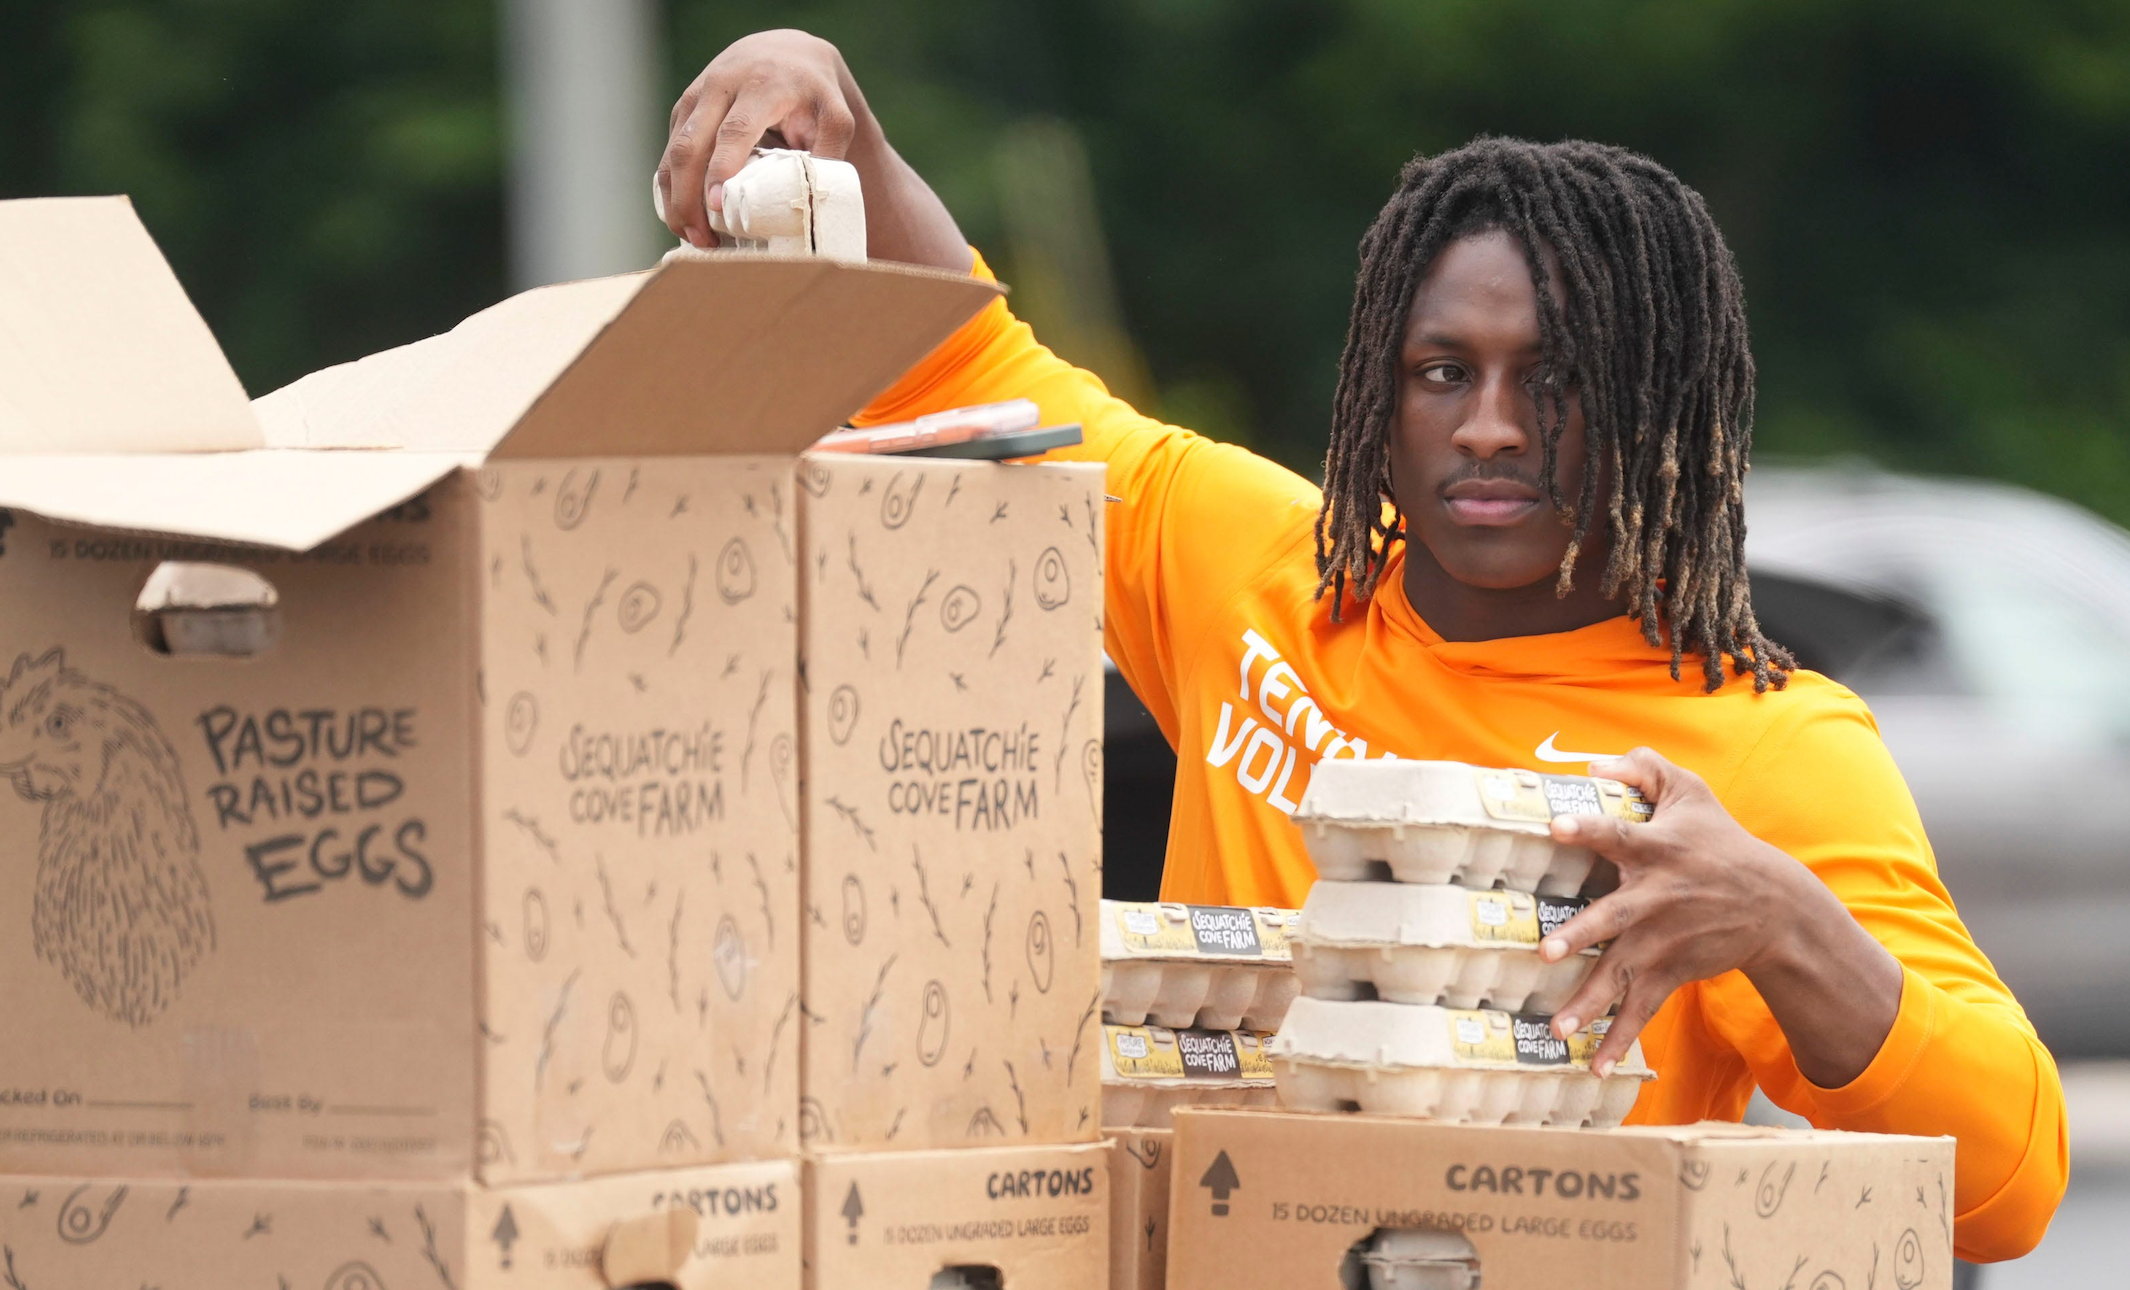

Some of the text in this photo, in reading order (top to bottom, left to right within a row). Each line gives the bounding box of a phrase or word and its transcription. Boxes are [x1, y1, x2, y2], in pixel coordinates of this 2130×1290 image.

[194, 705, 419, 776] PASTURE
[1206, 701, 1317, 816] VOL
[205, 767, 405, 830] RAISED
[569, 780, 726, 838] COVE FARM
[888, 778, 1039, 832] COVE FARM
[245, 817, 434, 904] EGGS
[1199, 930, 1257, 950] COVE FARM
[1184, 1052, 1237, 1073] COVE FARM
[1517, 1039, 1567, 1060] COVE FARM
[53, 1088, 83, 1107] On
[986, 1167, 1095, 1200] CARTONS
[1445, 1163, 1642, 1202] CARTONS
[1017, 1216, 1058, 1238] LARGE
[1058, 1214, 1090, 1236] EGGS
[1272, 1203, 1290, 1221] 15
[1296, 1204, 1369, 1225] DOZEN
[1501, 1214, 1572, 1239] LARGE
[1578, 1219, 1638, 1243] EGGS
